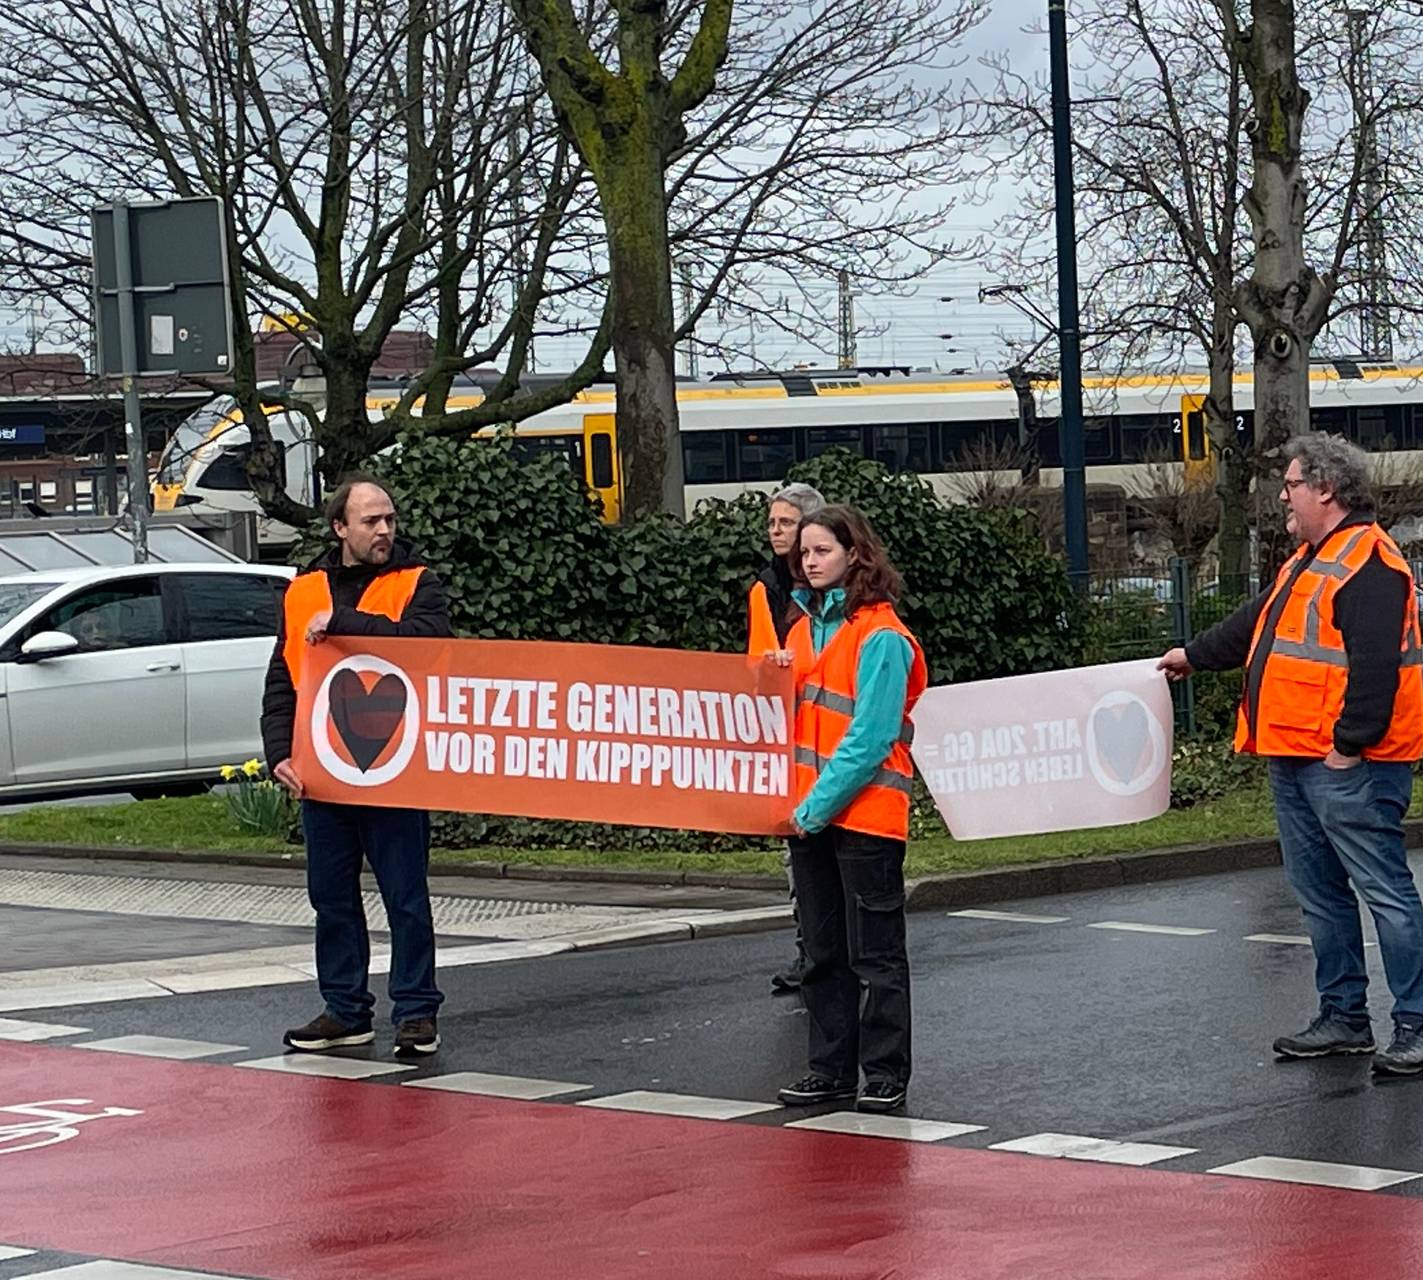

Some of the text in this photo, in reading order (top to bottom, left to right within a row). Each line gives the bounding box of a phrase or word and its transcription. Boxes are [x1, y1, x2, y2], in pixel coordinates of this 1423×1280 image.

[1172, 418, 1181, 434] 2
[1235, 415, 1245, 431] 2
[426, 675, 788, 745] LETZTE GENERATION
[424, 731, 789, 797] VOR DEN KIPPPUNKTEN
